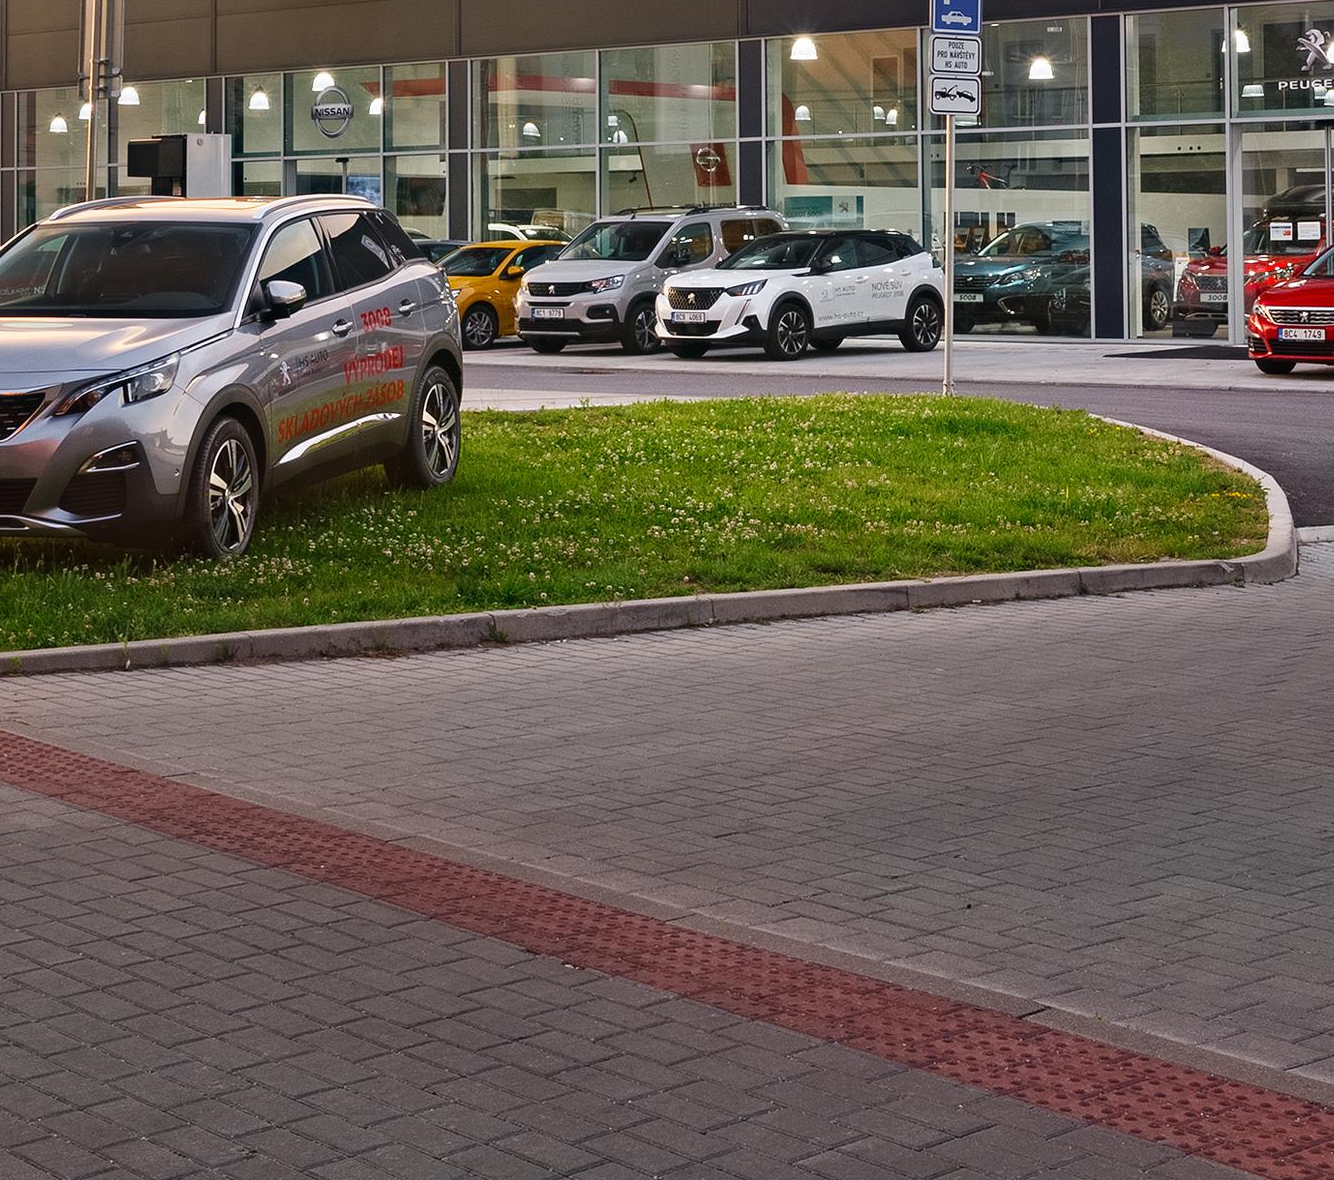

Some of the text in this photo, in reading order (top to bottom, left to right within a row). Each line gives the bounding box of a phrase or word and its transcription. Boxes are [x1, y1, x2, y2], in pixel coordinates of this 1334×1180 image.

[948, 41, 965, 50] POUZE
[937, 50, 948, 58] PRO
[945, 60, 968, 69] HS AUTO
[314, 107, 350, 116] NISSAN
[361, 307, 392, 332] 3008
[1284, 330, 1321, 338] 8C4 1749
[343, 345, 404, 385] VÝPRODEJ
[278, 379, 405, 444] SKLADOVÝCH ZÁSOB
